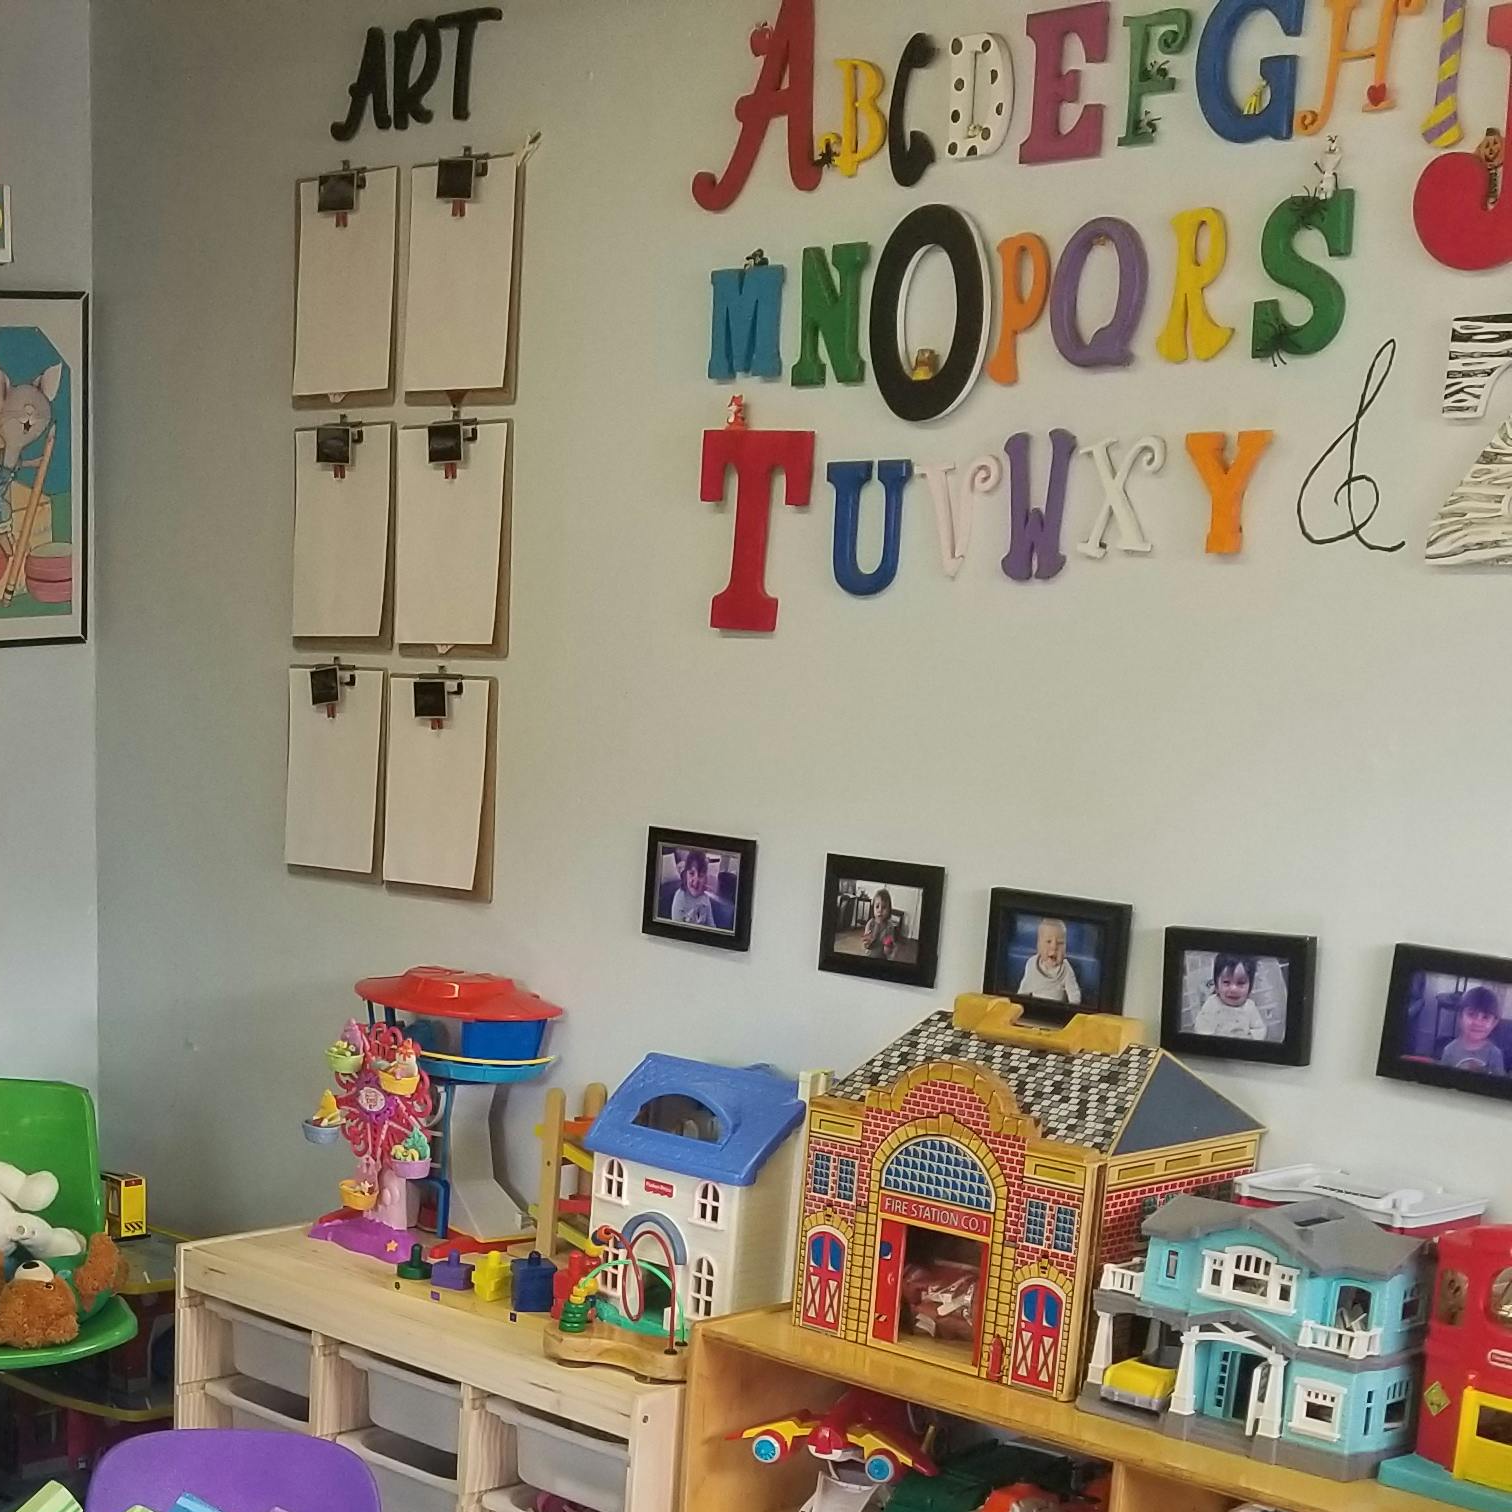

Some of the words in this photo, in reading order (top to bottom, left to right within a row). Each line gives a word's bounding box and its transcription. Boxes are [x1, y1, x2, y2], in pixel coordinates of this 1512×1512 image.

[330, 7, 503, 141] ART
[884, 1197, 909, 1216] FIRE
[911, 1203, 959, 1227] STATION
